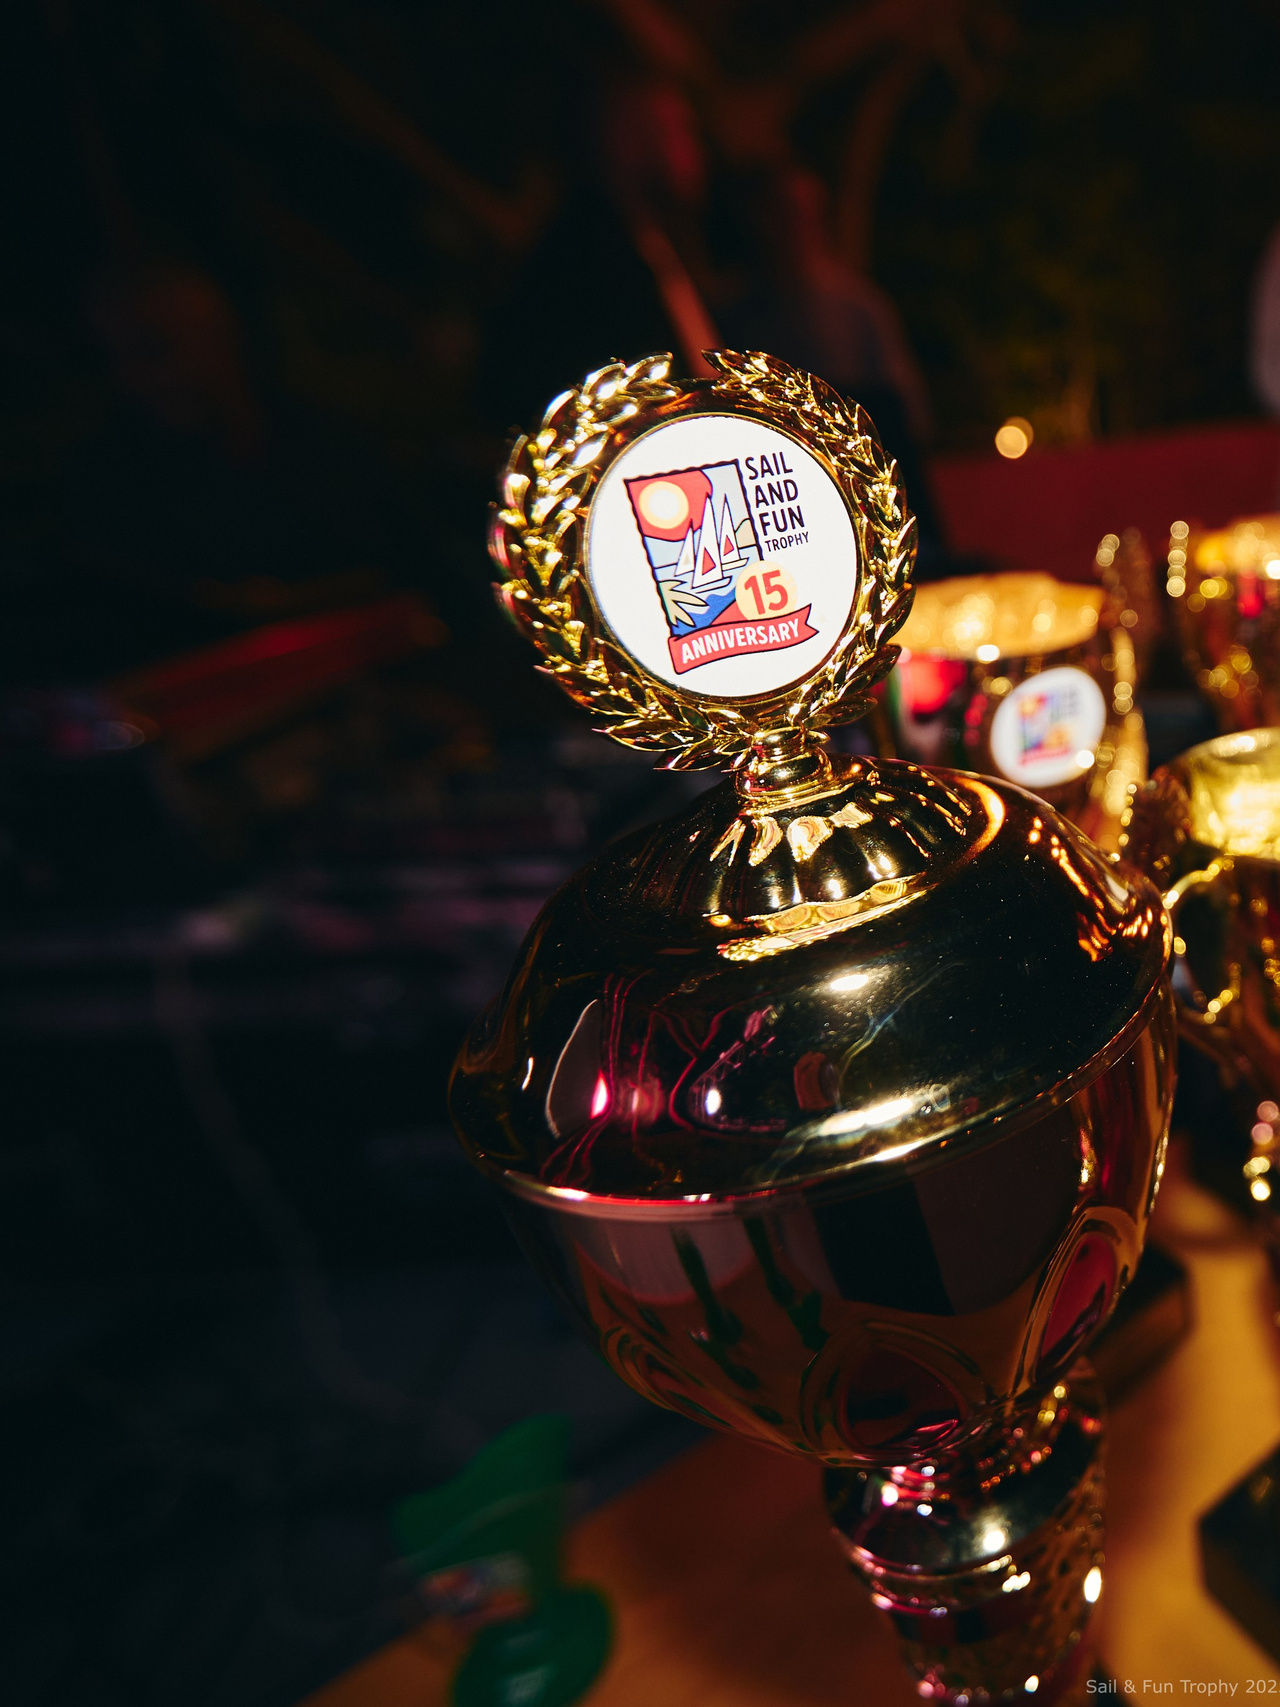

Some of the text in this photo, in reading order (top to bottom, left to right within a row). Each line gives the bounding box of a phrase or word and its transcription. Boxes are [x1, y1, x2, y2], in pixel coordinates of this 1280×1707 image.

[745, 451, 793, 481] SAIL
[755, 479, 799, 509] AND
[759, 505, 805, 536] FUN
[764, 531, 810, 553] TROPHY
[744, 569, 789, 616] 15
[681, 618, 801, 664] ANNIVERSARY
